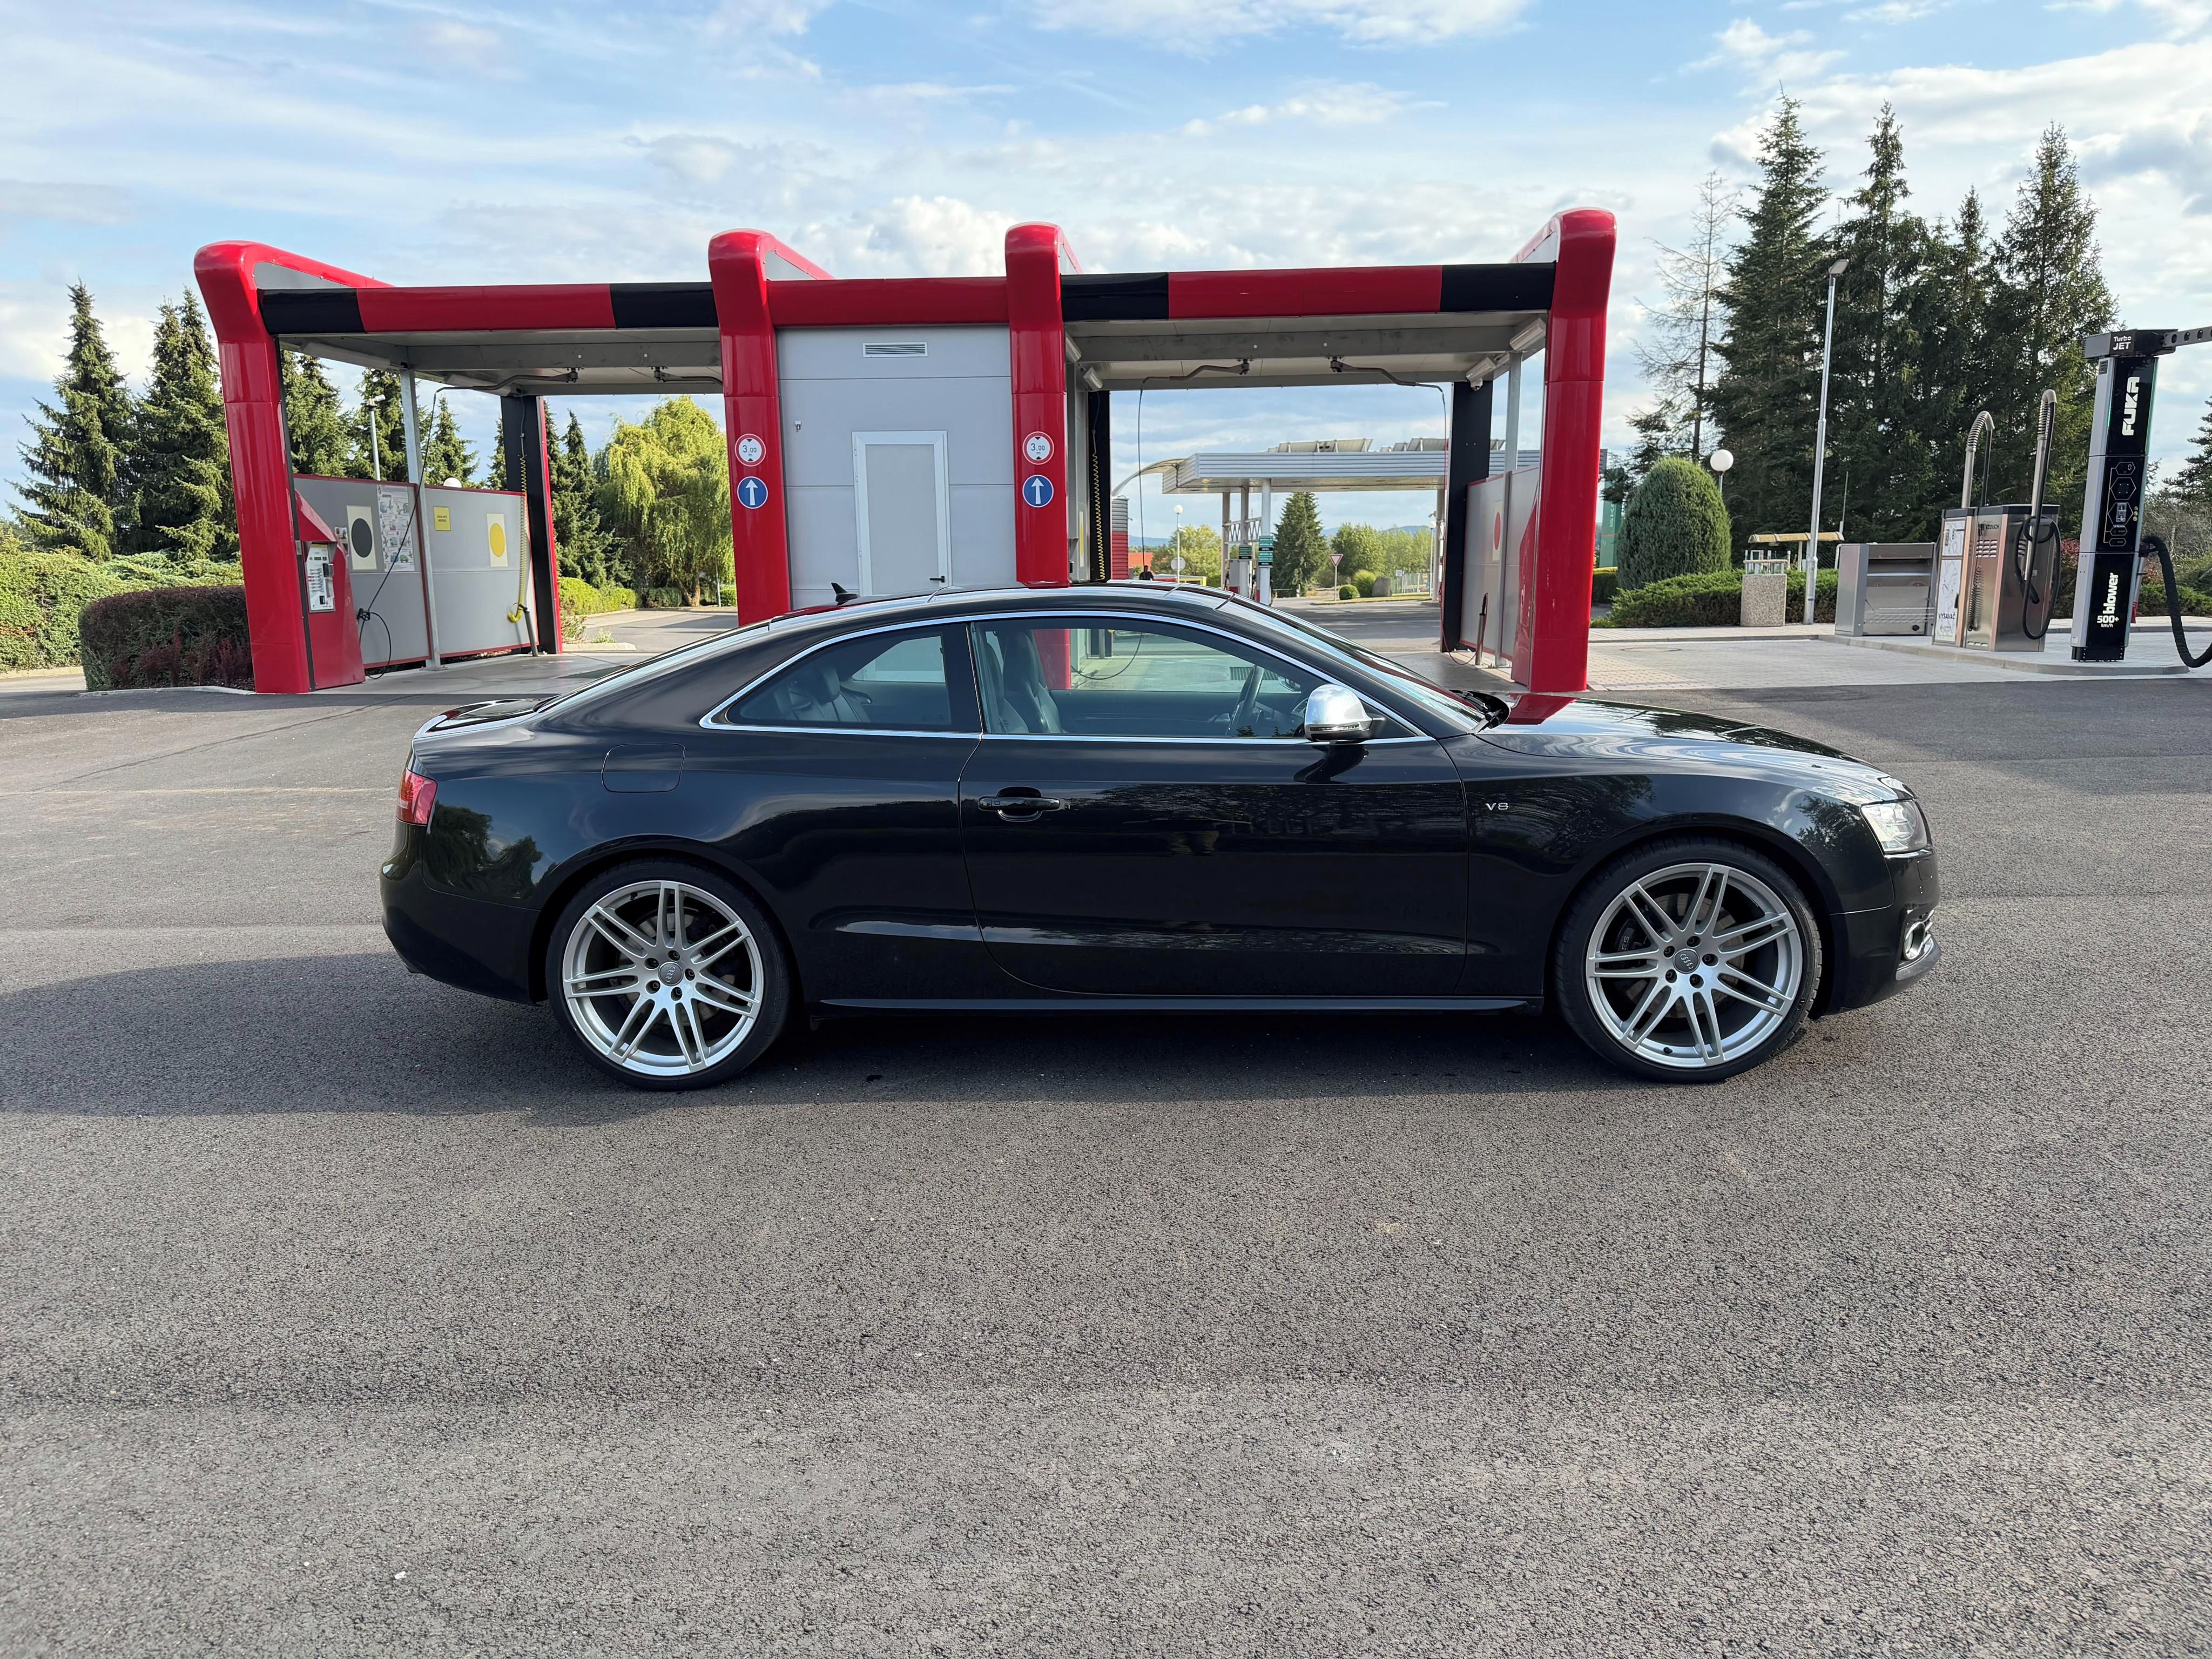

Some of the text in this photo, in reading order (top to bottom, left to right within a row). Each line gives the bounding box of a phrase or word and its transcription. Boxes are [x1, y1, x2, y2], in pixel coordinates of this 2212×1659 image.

[2113, 342, 2131, 350] JET
[2122, 376, 2140, 436] FUKA
[2102, 572, 2119, 614] blower
[1485, 802, 1508, 811] V8
